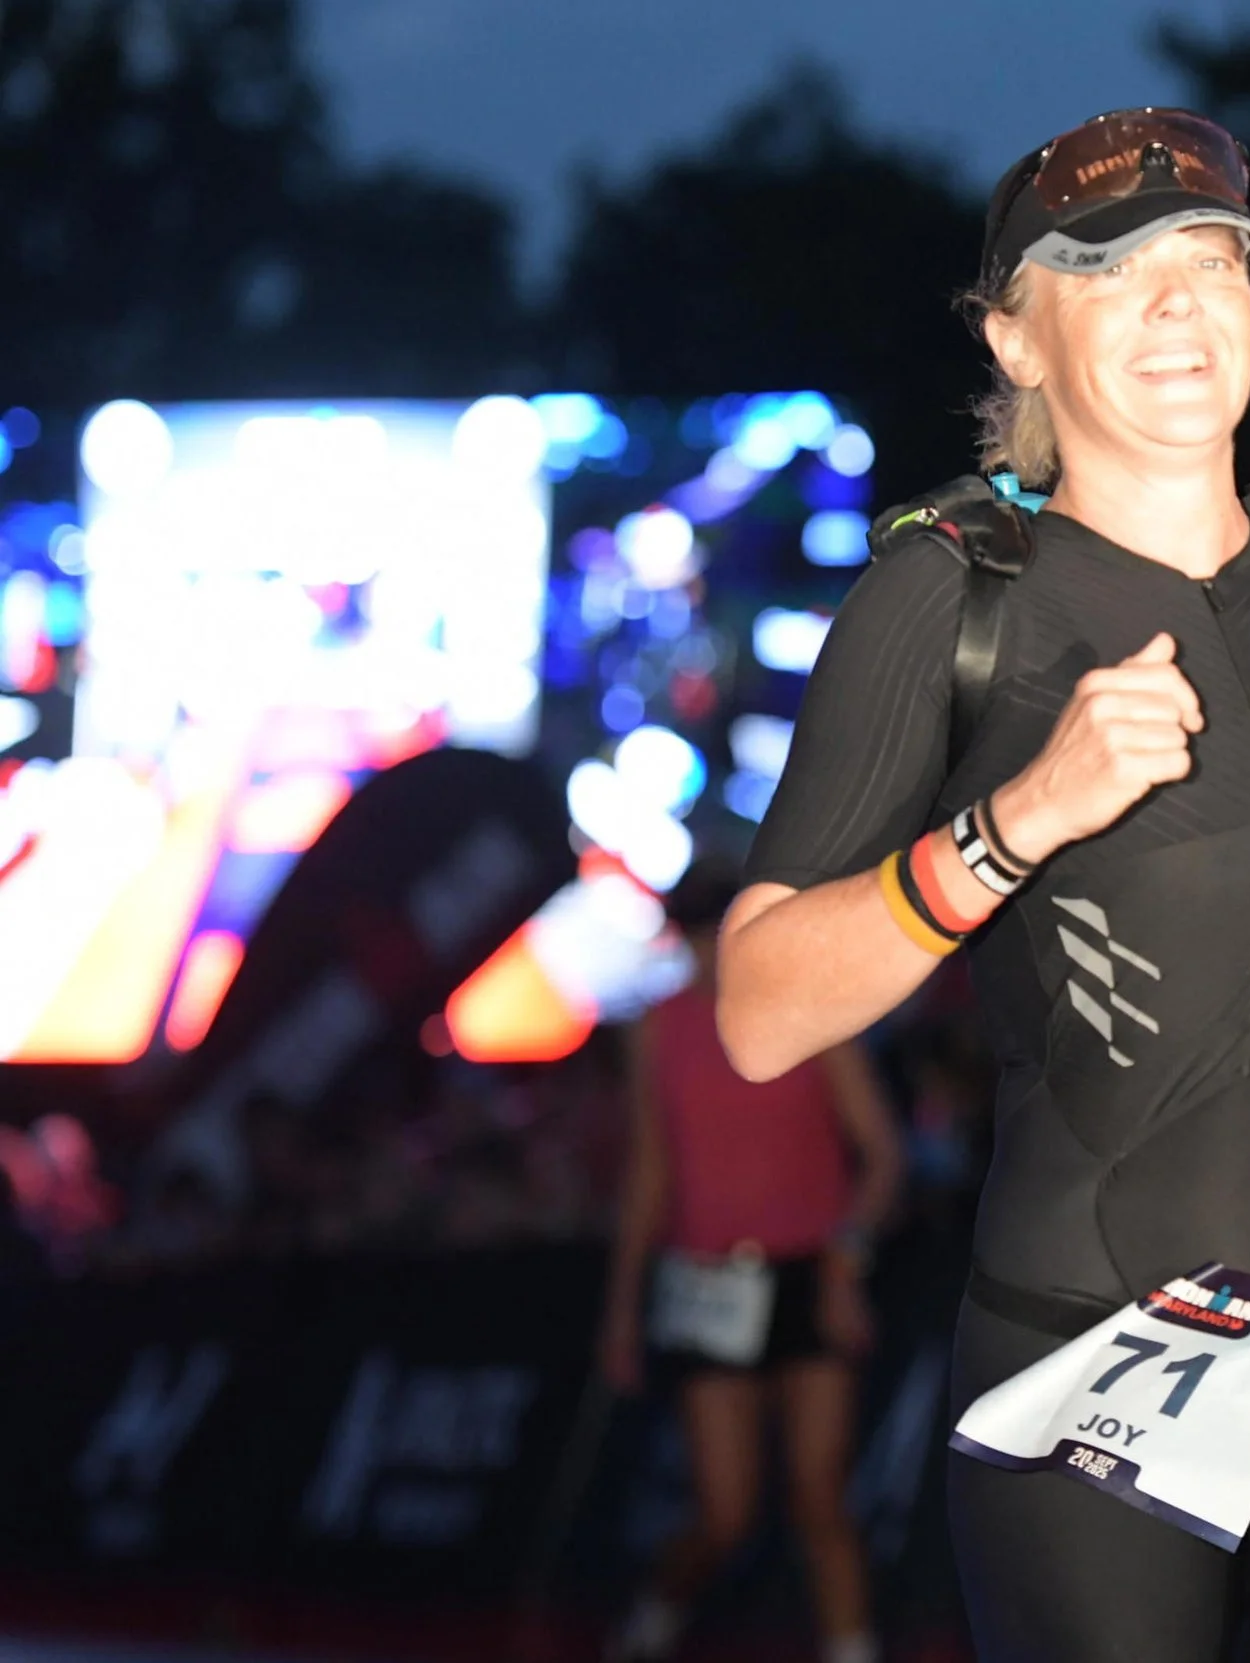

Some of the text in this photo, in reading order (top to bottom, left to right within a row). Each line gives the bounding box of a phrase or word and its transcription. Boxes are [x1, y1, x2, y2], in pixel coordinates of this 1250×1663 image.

[1089, 1331, 1218, 1419] 71
[1077, 1412, 1148, 1448] JOY
[1067, 1447, 1095, 1468] 20
